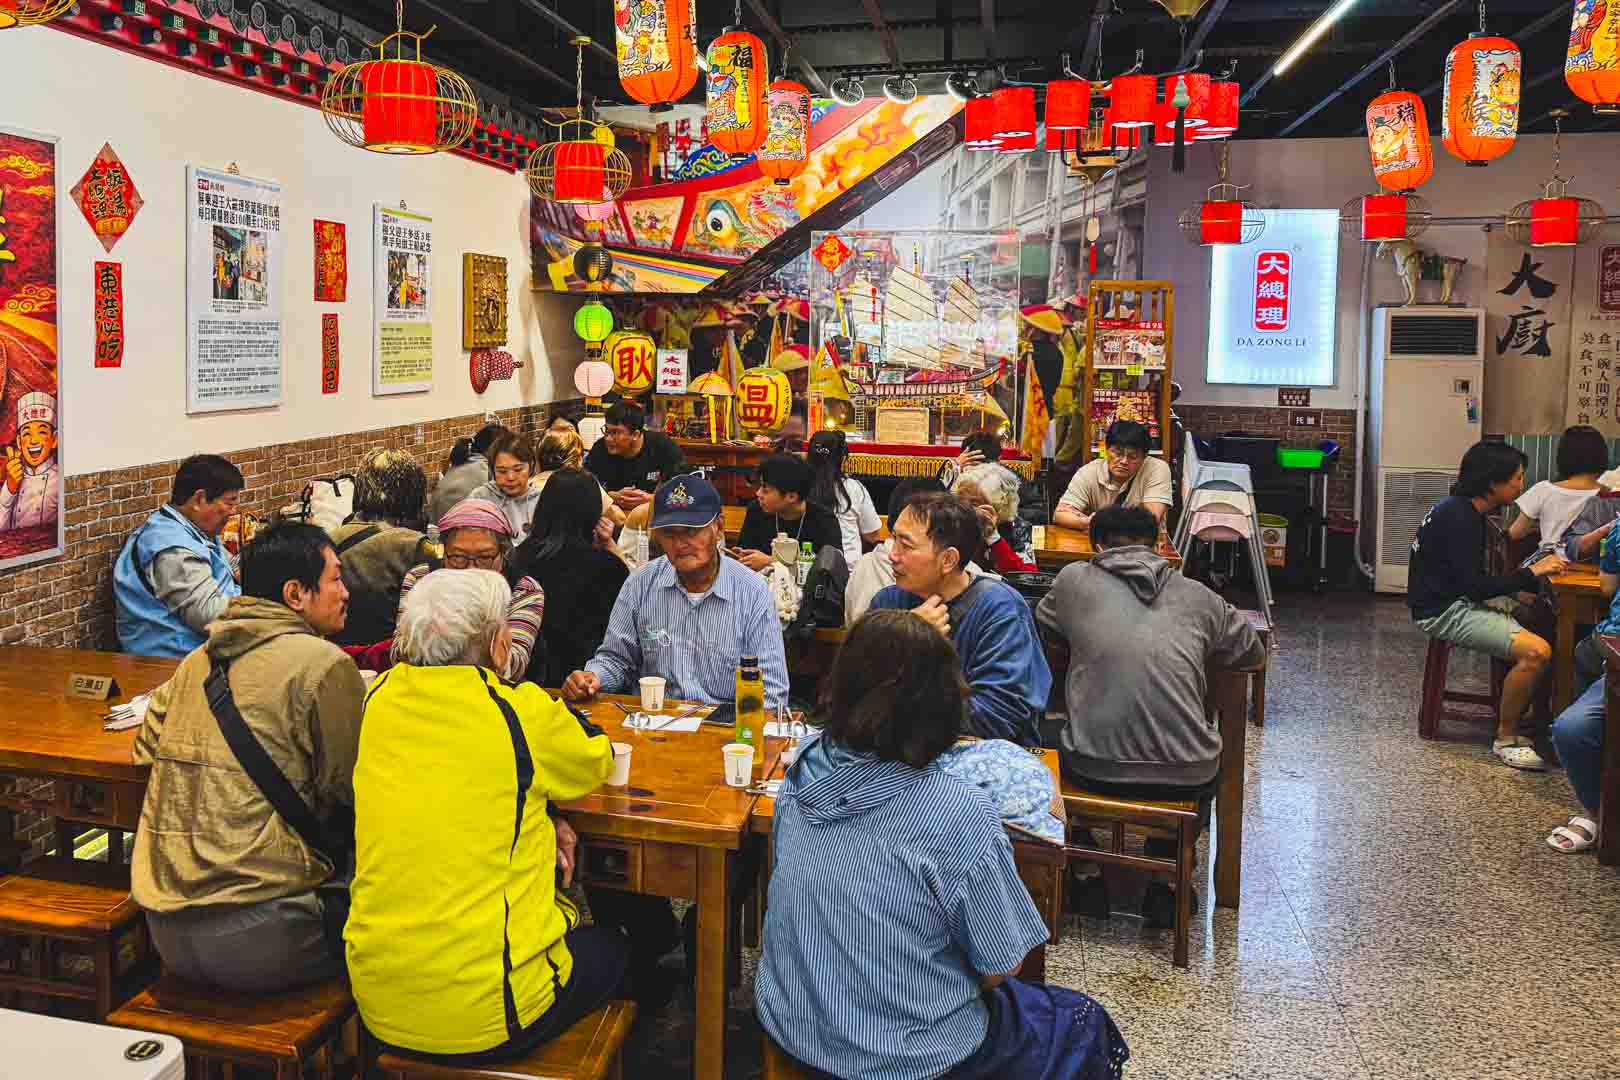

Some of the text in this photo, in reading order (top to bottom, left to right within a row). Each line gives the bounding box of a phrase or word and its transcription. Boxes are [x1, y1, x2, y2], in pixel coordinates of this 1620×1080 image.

[1254, 255, 1289, 326] 大總理
[1236, 337, 1306, 347] DA ZONG LI
[616, 345, 653, 385] 耿
